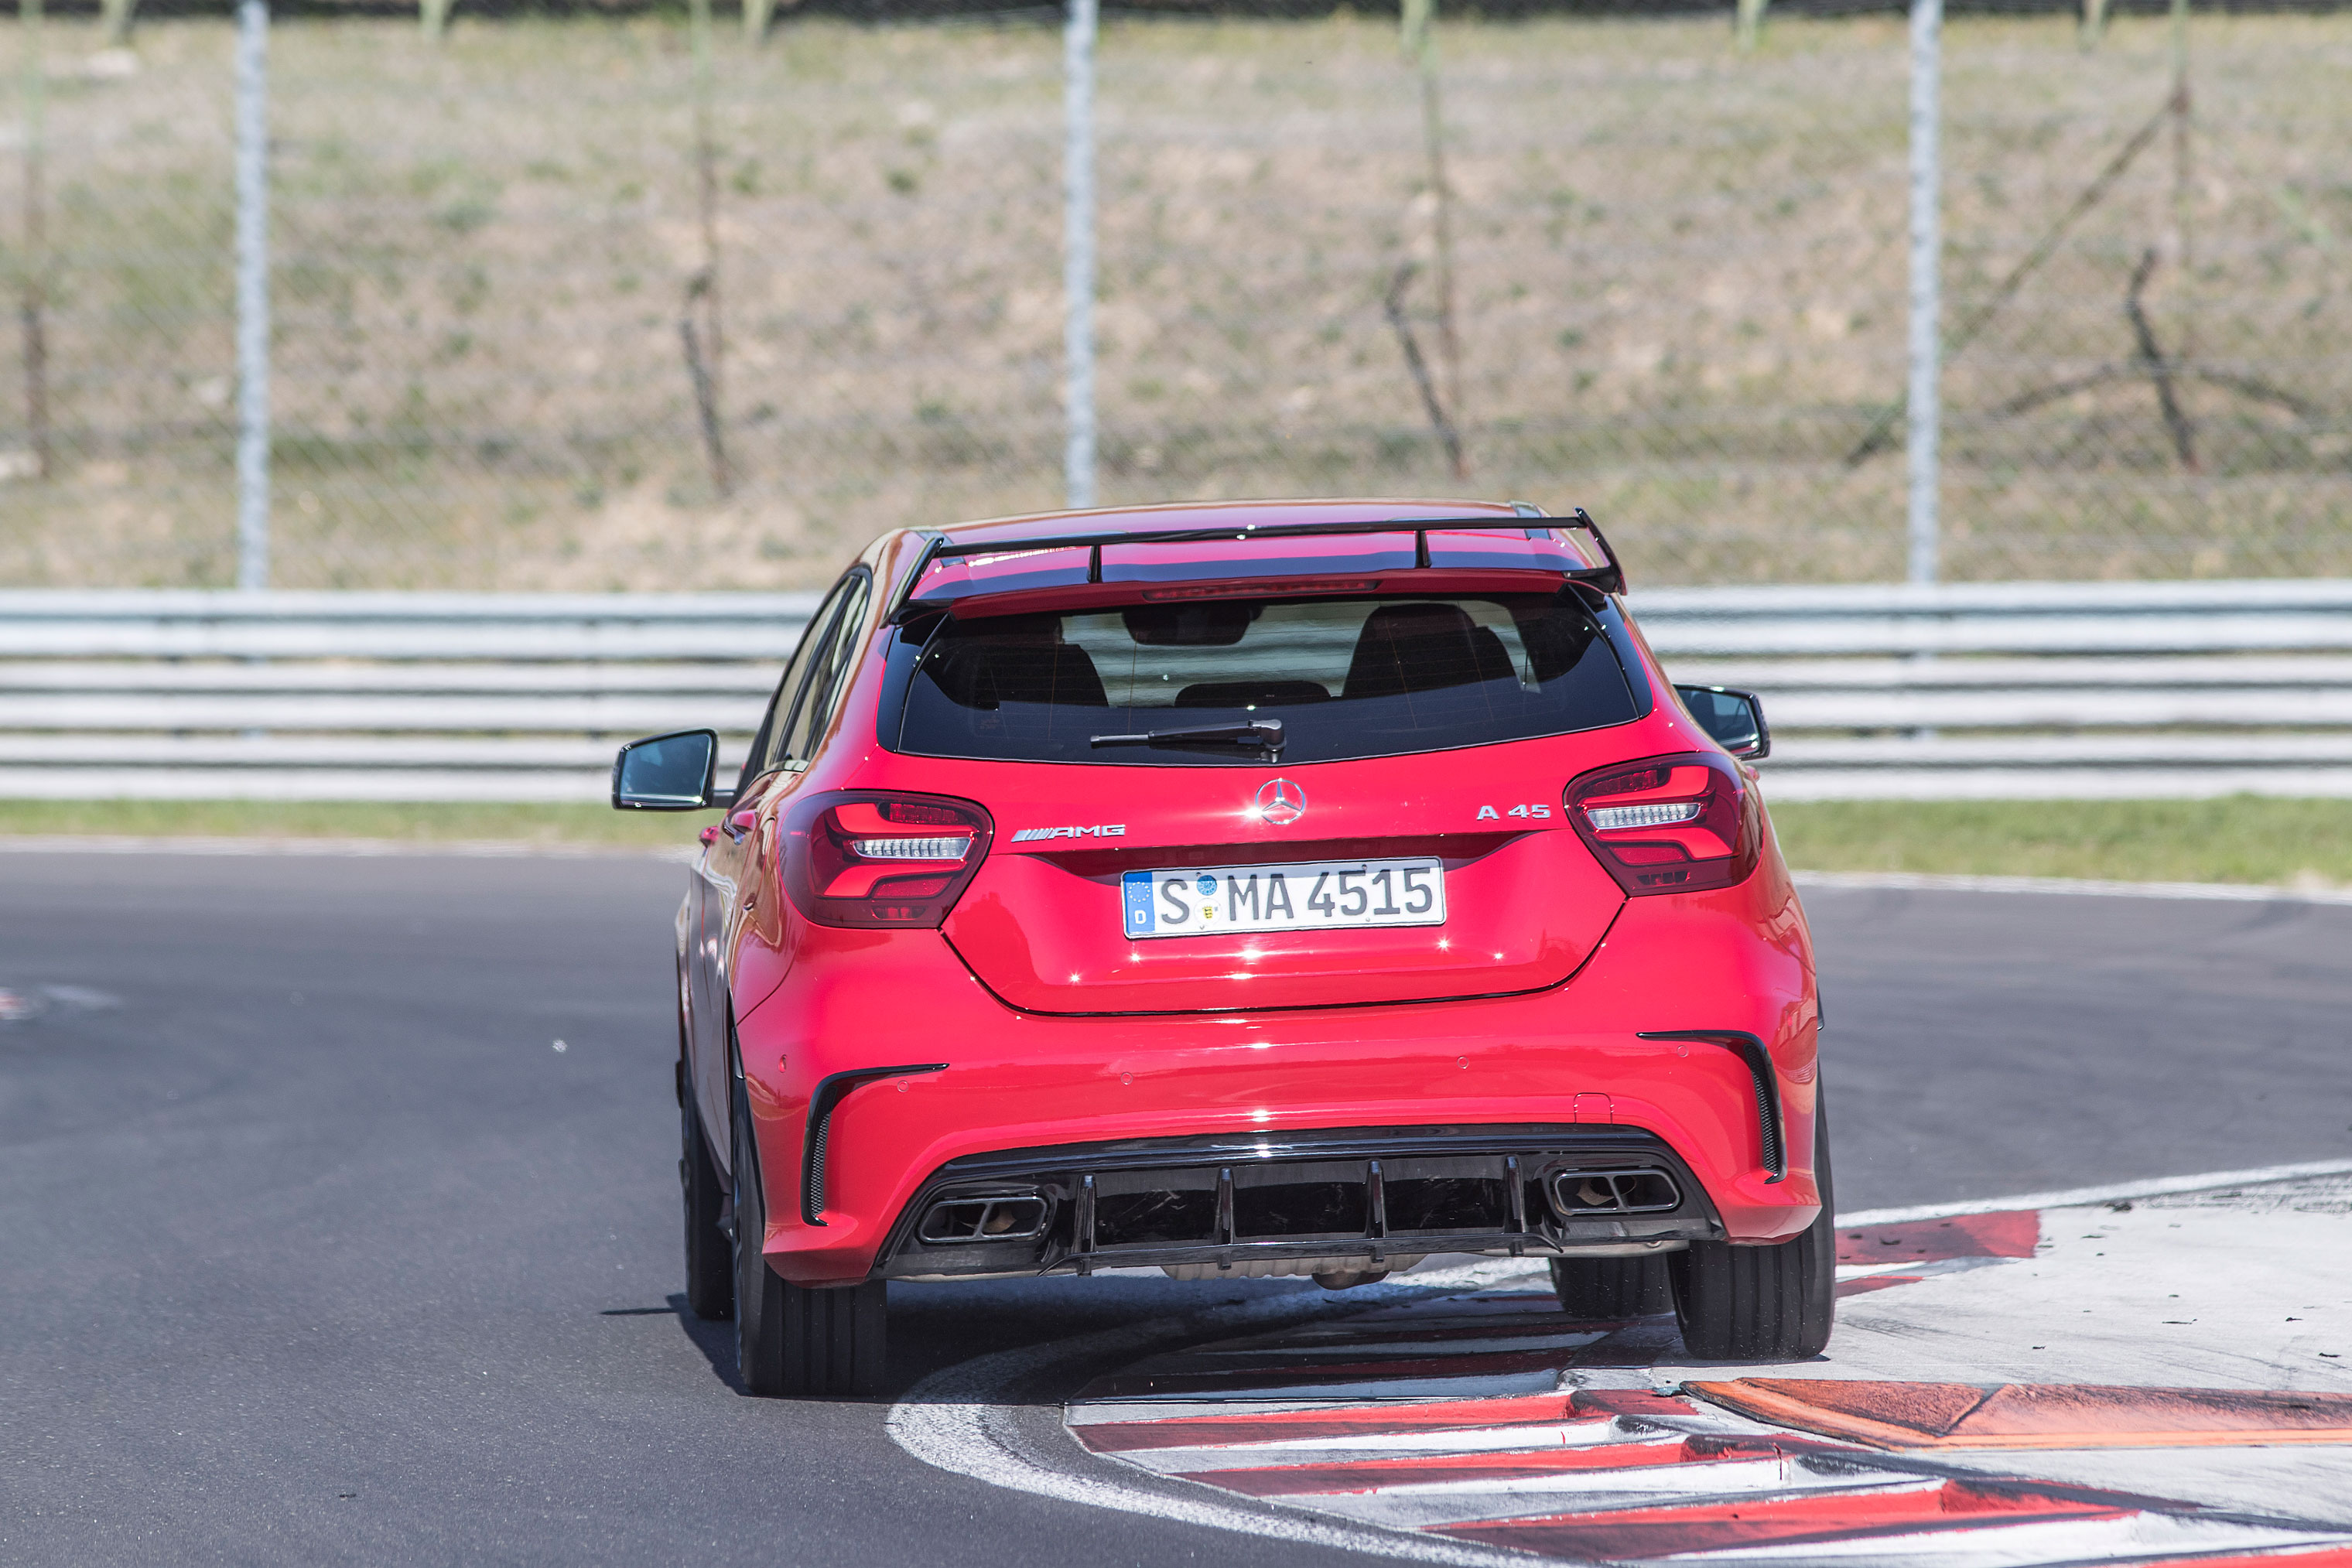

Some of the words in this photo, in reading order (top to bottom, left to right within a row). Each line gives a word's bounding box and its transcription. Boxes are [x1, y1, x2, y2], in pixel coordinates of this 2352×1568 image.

[1476, 805, 1499, 820] A
[1508, 804, 1550, 818] 45
[1047, 825, 1126, 839] AMG
[1161, 879, 1190, 924] S
[1227, 874, 1294, 921] MA
[1308, 868, 1432, 917] 4515
[1134, 910, 1147, 924] D
